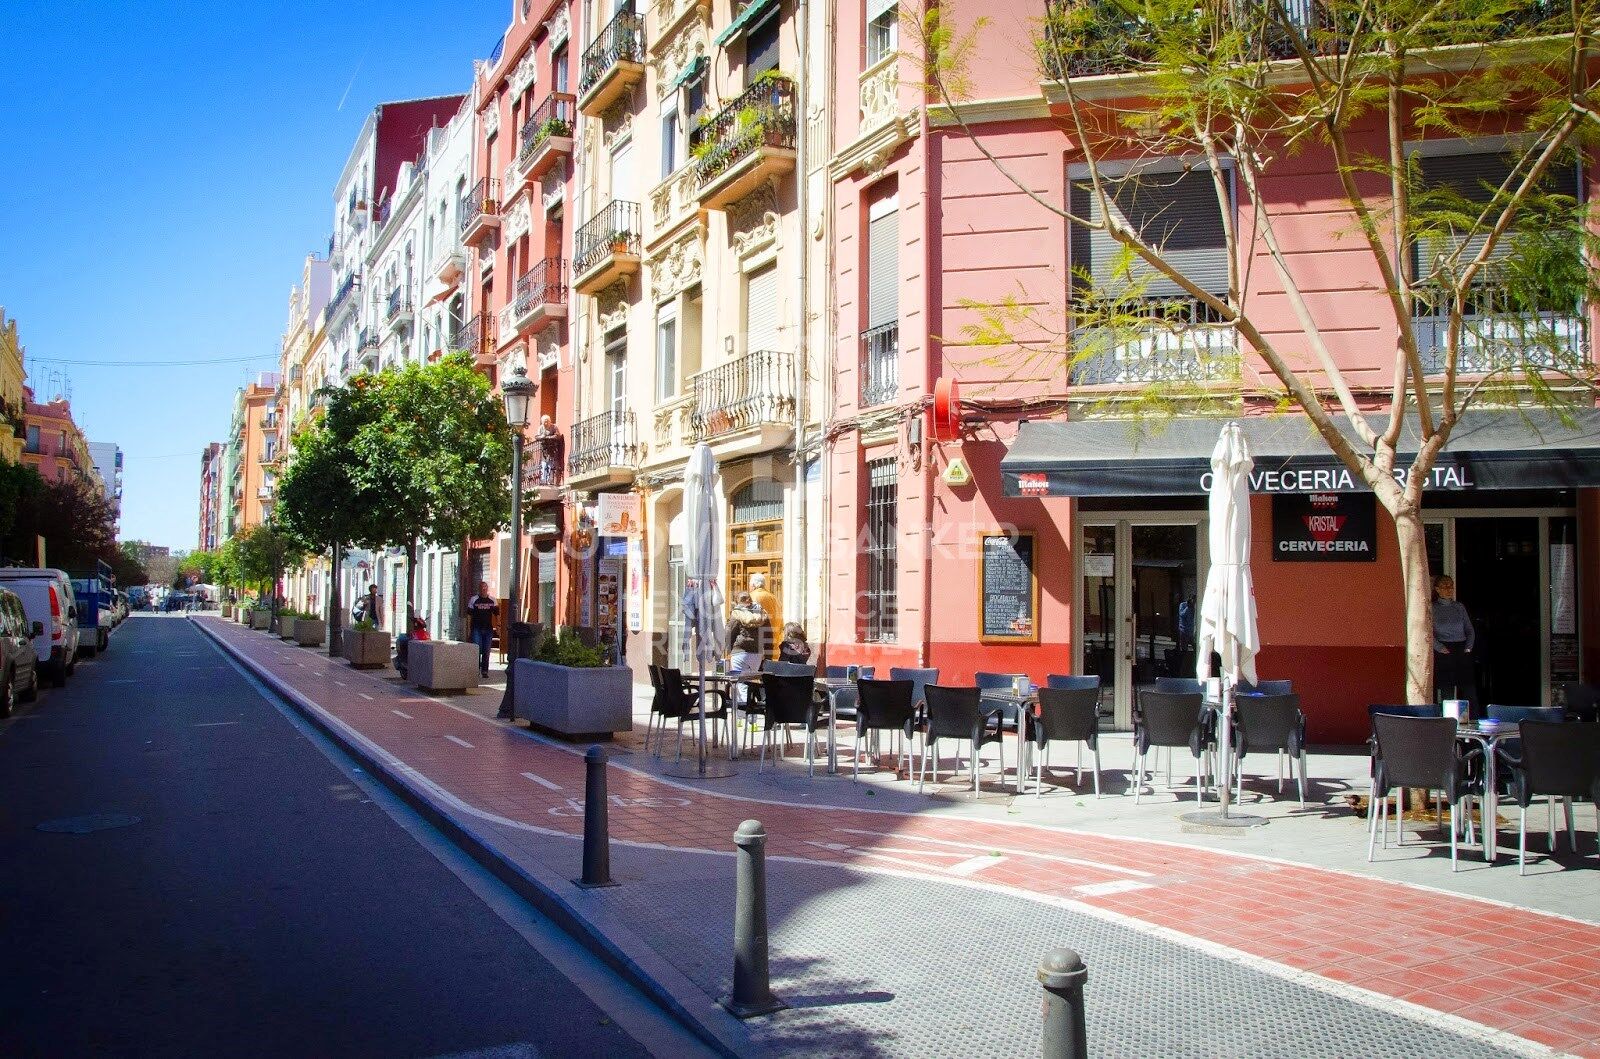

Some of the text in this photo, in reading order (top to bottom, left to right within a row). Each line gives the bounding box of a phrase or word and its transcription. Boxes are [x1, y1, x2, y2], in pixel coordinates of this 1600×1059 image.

[1200, 467, 1474, 491] CVECERIA RTAL
[1309, 515, 1340, 532] KRISTAL
[1279, 540, 1369, 552] CERVECERIA
